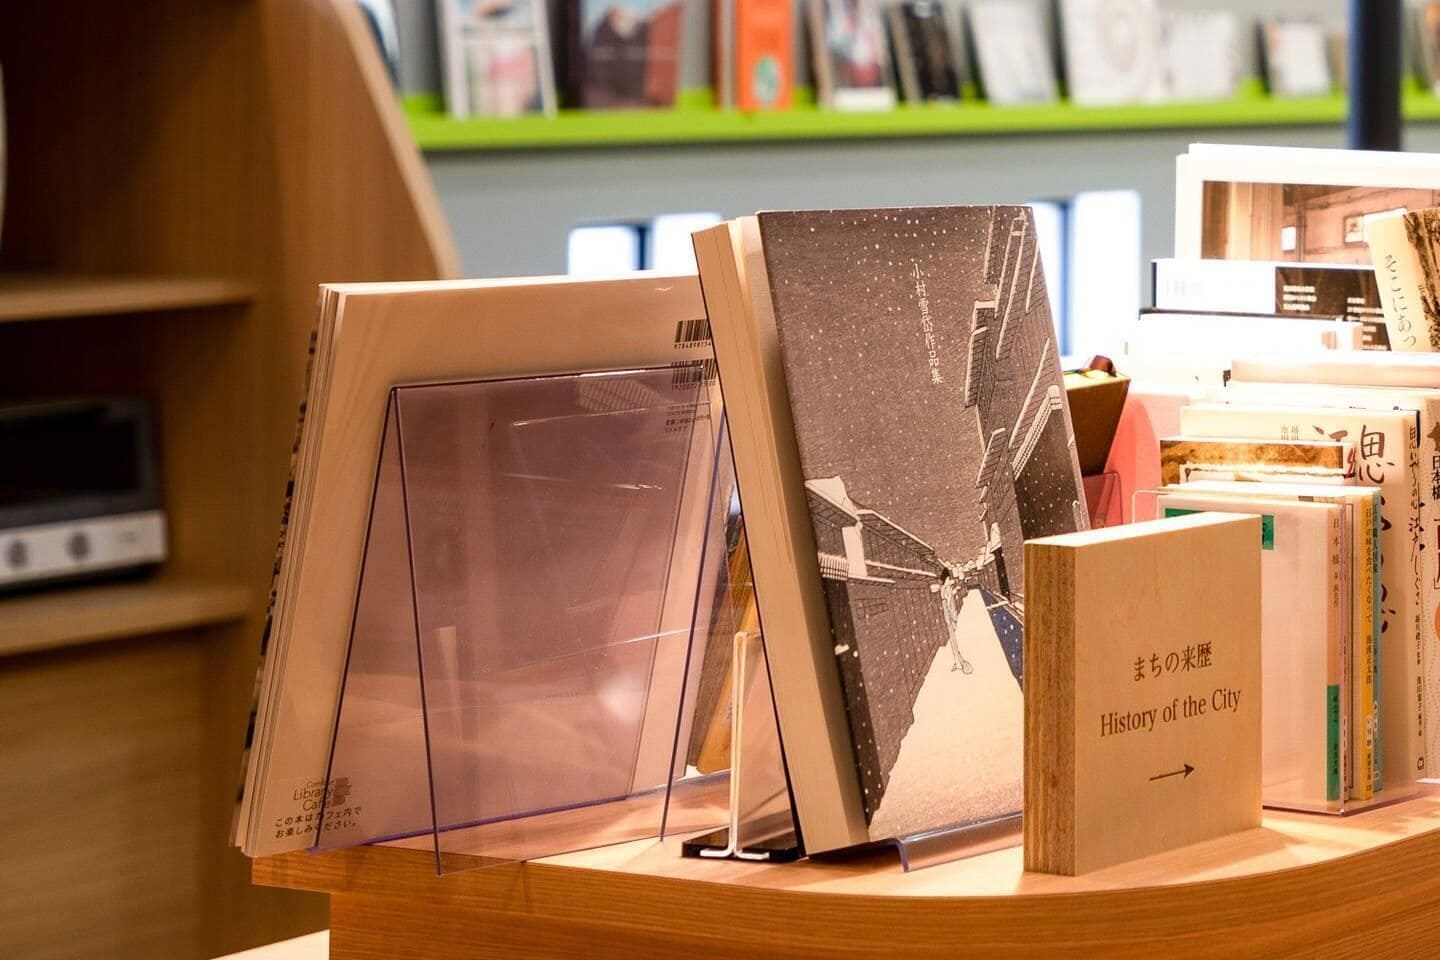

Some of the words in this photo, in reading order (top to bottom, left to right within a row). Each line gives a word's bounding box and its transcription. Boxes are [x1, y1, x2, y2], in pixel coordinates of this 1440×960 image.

[1133, 641, 1213, 682] まちの来歴
[1100, 708, 1158, 738] History
[1162, 698, 1179, 723] of
[1183, 695, 1206, 719] the
[1212, 687, 1241, 713] City
